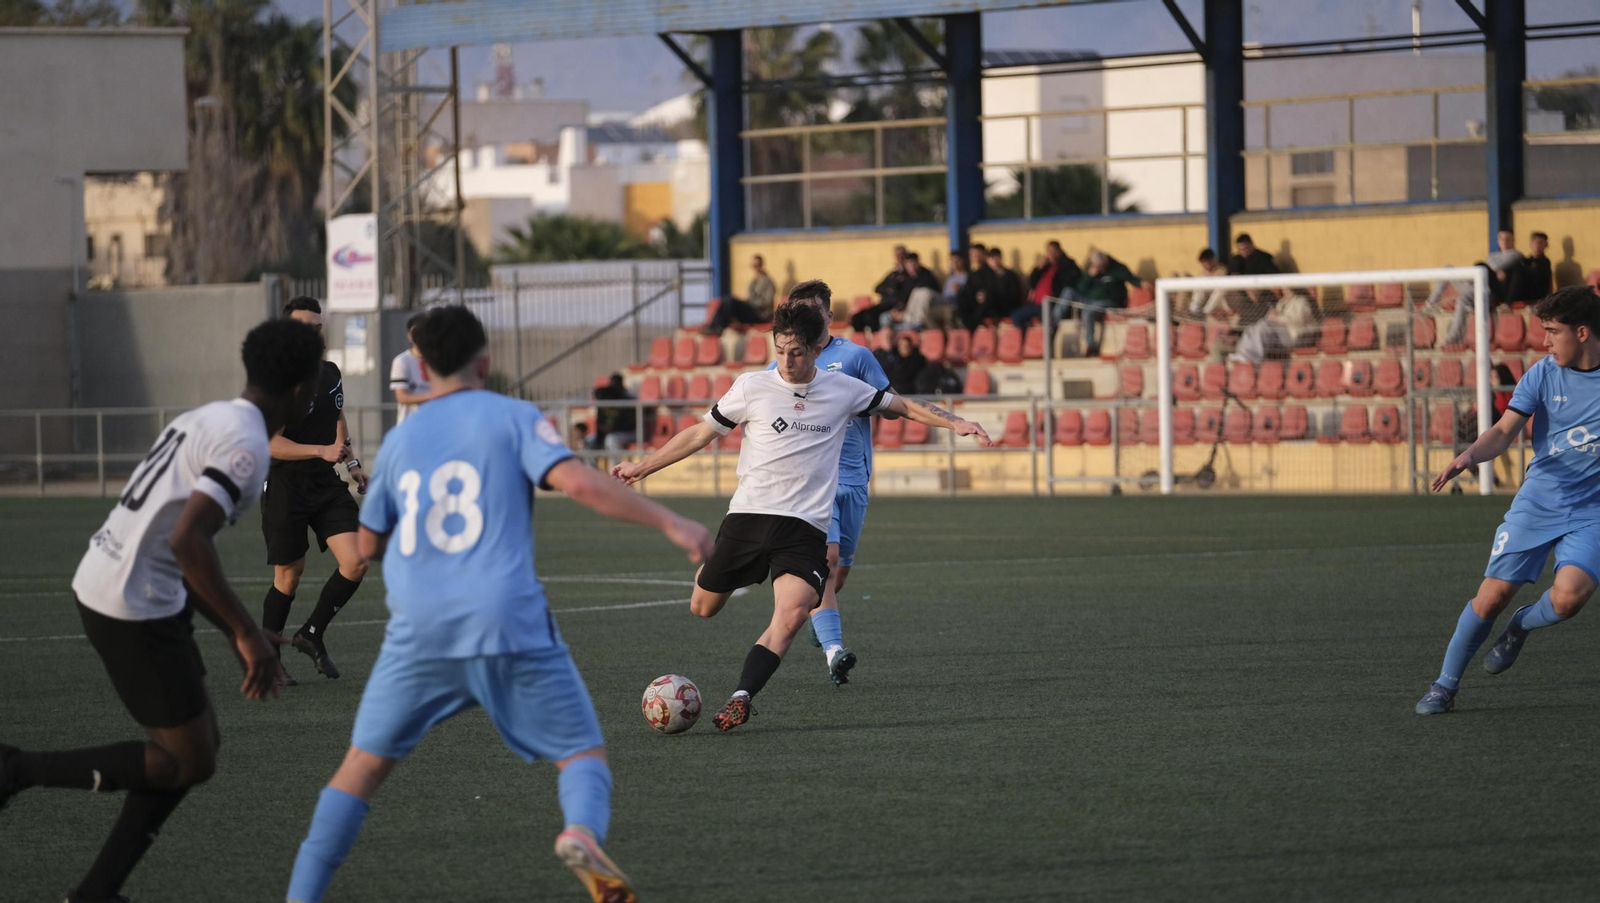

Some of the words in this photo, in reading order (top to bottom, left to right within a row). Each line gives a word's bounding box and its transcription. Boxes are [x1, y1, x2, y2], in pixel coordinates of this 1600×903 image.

[790, 421, 831, 433] Alprosan
[398, 460, 483, 556] 18
[1491, 531, 1509, 555] 3
